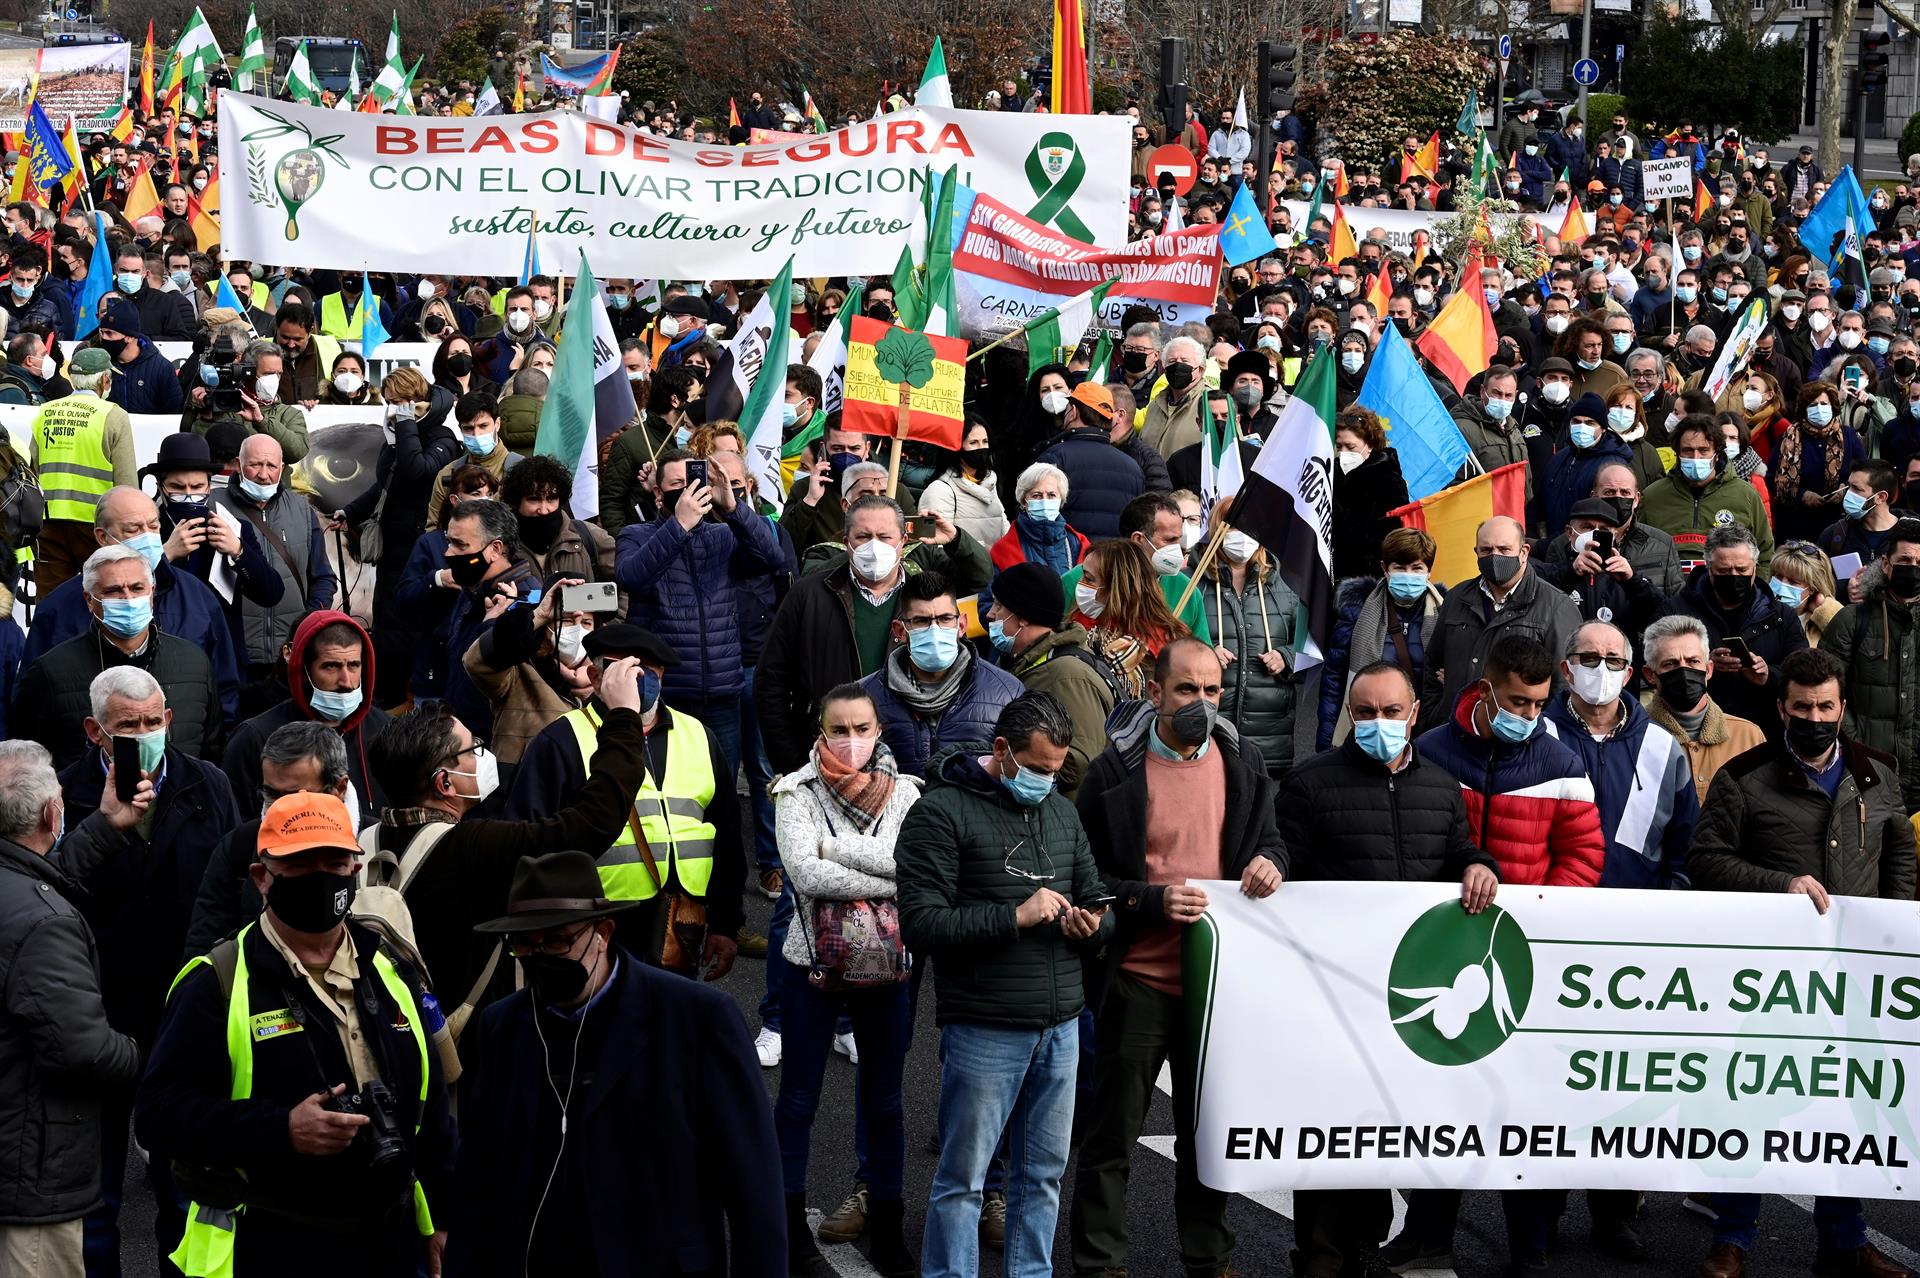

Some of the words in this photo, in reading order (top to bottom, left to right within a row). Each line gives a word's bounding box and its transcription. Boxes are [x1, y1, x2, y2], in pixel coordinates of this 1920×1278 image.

[375, 120, 560, 155] BEAS
[585, 121, 671, 163] DE
[695, 120, 975, 167] SEGURA
[369, 165, 462, 192] CON
[479, 167, 528, 192] EL
[541, 167, 692, 202] OLIVAR
[705, 166, 972, 202] TRADICION
[1646, 187, 1664, 196] HAY
[1667, 184, 1690, 194] VIDA
[1658, 173, 1672, 182] NO
[608, 211, 751, 240] cultura
[751, 222, 789, 252] y
[790, 207, 912, 246] futuro
[971, 203, 998, 229] SIN
[992, 214, 1072, 257] GANADEROS
[1154, 235, 1175, 257] NO
[963, 231, 1001, 262] HUGO
[1041, 257, 1101, 281] TRAIDOR
[851, 345, 895, 366] MUNDO
[935, 361, 963, 382] RURAL
[847, 384, 888, 402] MORAL
[900, 392, 910, 405] DE
[848, 370, 888, 387] SIEMBRA
[925, 386, 958, 398] FUTURO
[51, 427, 75, 437] JUSTOS
[57, 409, 65, 417] EL
[66, 410, 91, 419] OLIVAR
[281, 810, 316, 834] ARMERIA
[1557, 963, 1709, 1012] S.C.A.
[1728, 968, 1847, 1016] SAN
[1870, 974, 1920, 1020] IS
[1565, 1050, 1709, 1093] SILES
[1726, 1044, 1906, 1108] (JAÉN)
[1225, 1127, 1284, 1160] EN
[1297, 1124, 1486, 1160] DEFENSA
[1499, 1125, 1577, 1157] DEL
[1590, 1126, 1749, 1161] MUNDO
[1763, 1130, 1909, 1168] RURAL
